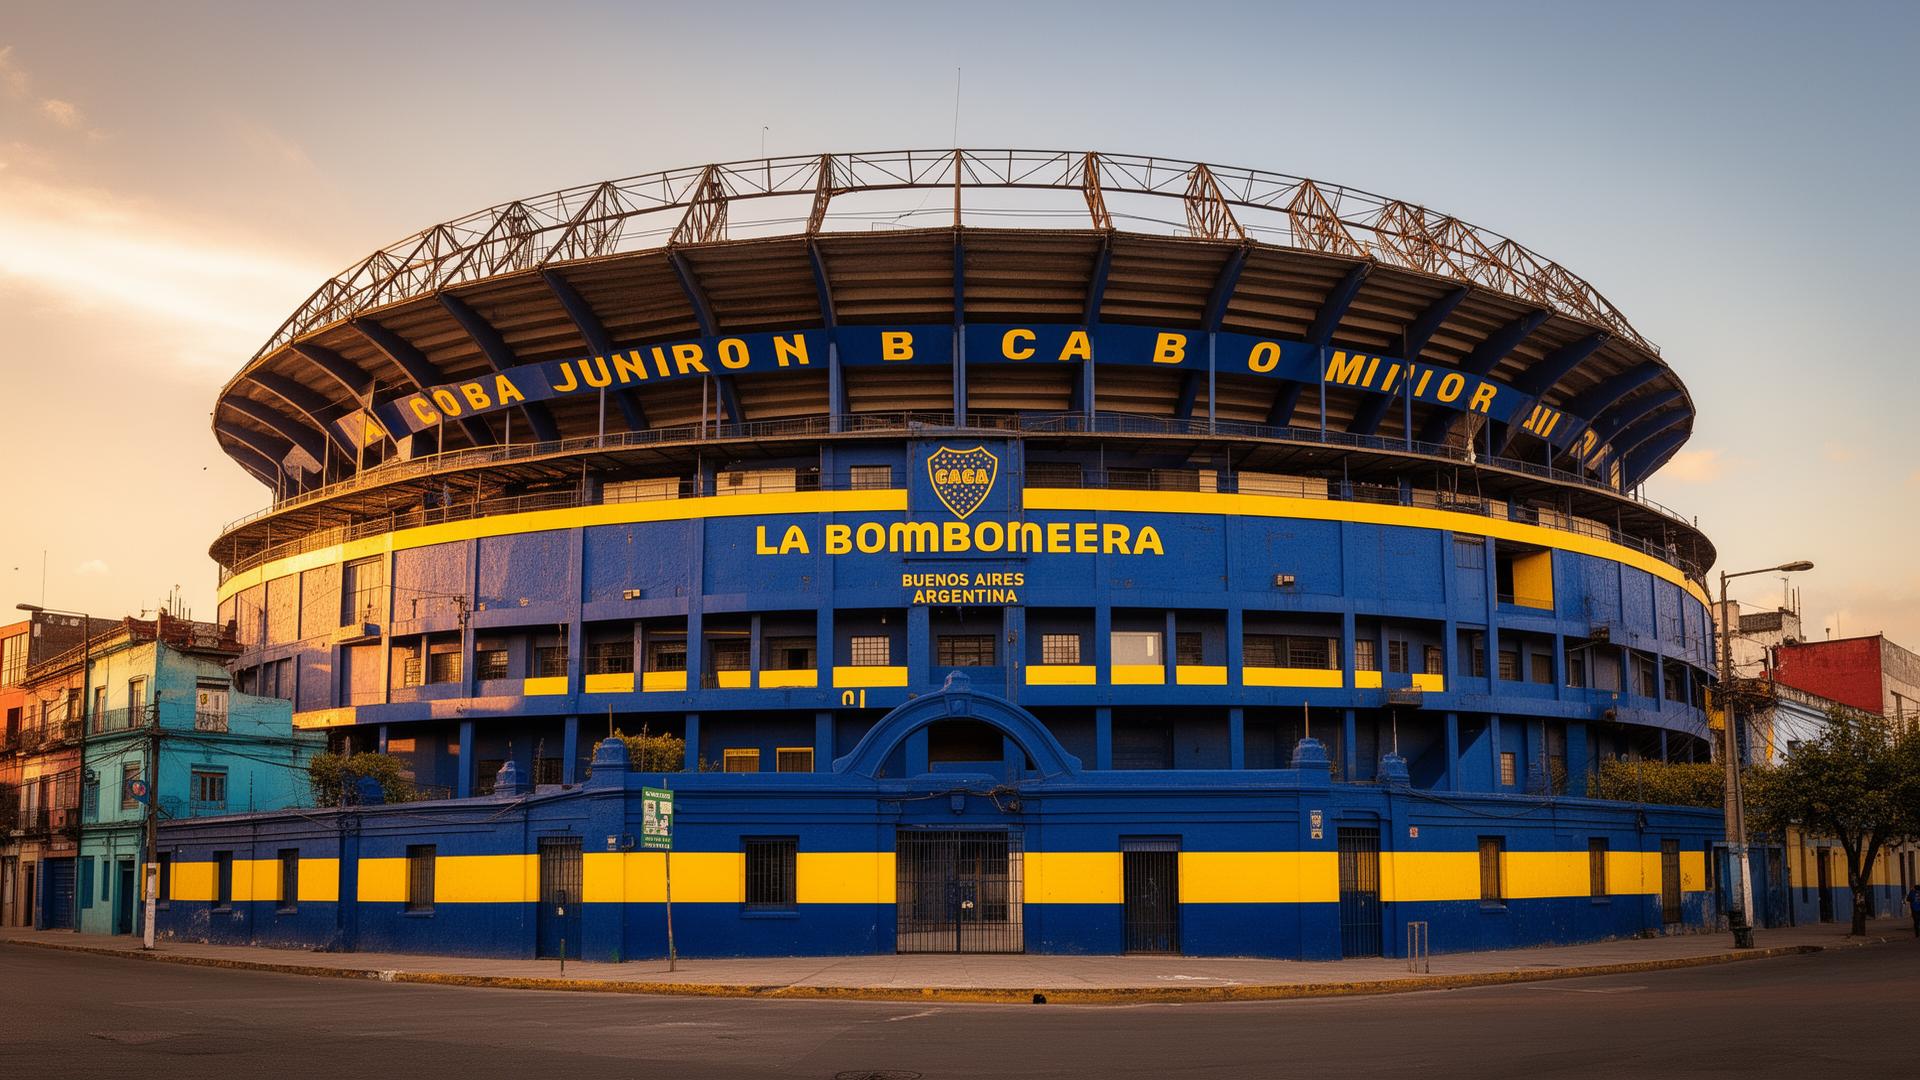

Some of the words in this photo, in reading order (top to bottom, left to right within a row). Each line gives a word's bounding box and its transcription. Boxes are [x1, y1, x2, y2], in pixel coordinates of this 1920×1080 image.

[408, 374, 526, 426] COBA
[881, 331, 914, 361] B
[1152, 332, 1188, 364] B
[756, 525, 809, 555] LA
[902, 573, 969, 587] BUENOS
[974, 573, 1025, 586] AIRES
[913, 589, 1018, 604] ARGENTINA
